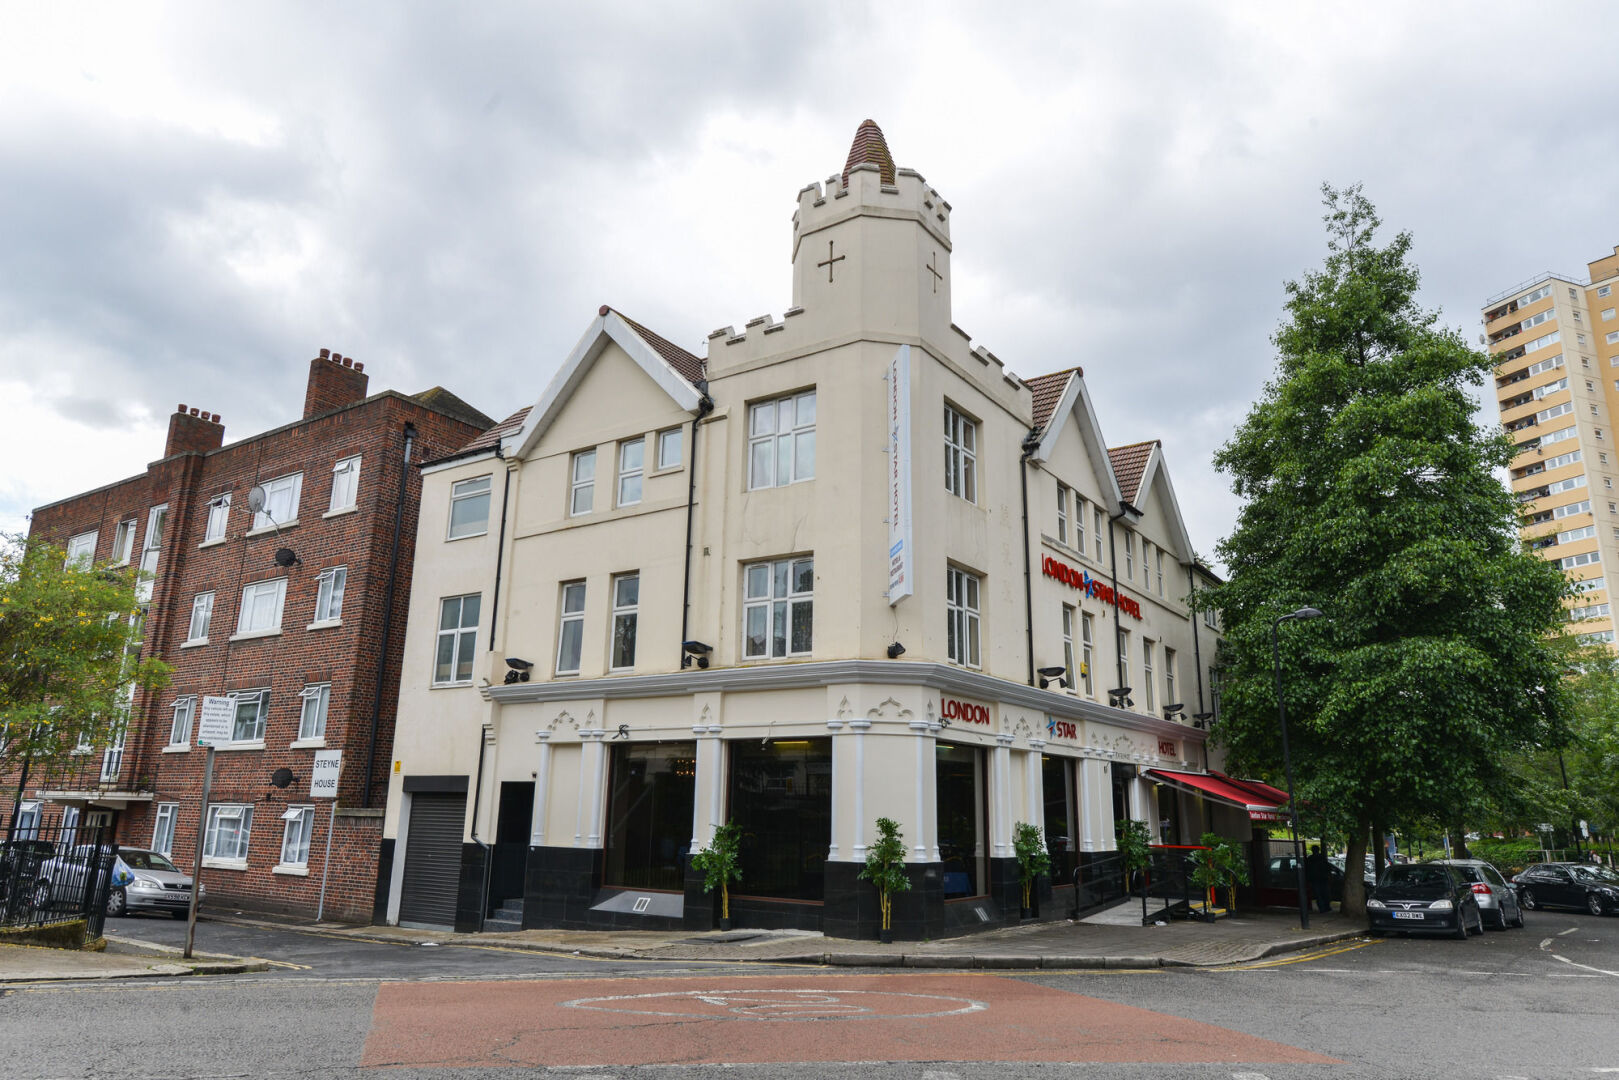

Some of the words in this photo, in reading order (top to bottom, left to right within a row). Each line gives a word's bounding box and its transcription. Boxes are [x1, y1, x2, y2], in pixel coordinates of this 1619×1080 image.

[1041, 553, 1084, 591] LONDON
[1092, 580, 1115, 606] STAR
[1115, 592, 1143, 620] HOTEL
[208, 698, 230, 707] Warning
[941, 698, 990, 725] LONDON
[1056, 721, 1077, 740] STAR
[1158, 741, 1177, 757] HOTEL
[315, 760, 339, 768] STEYNE
[314, 779, 336, 788] HOUSE
